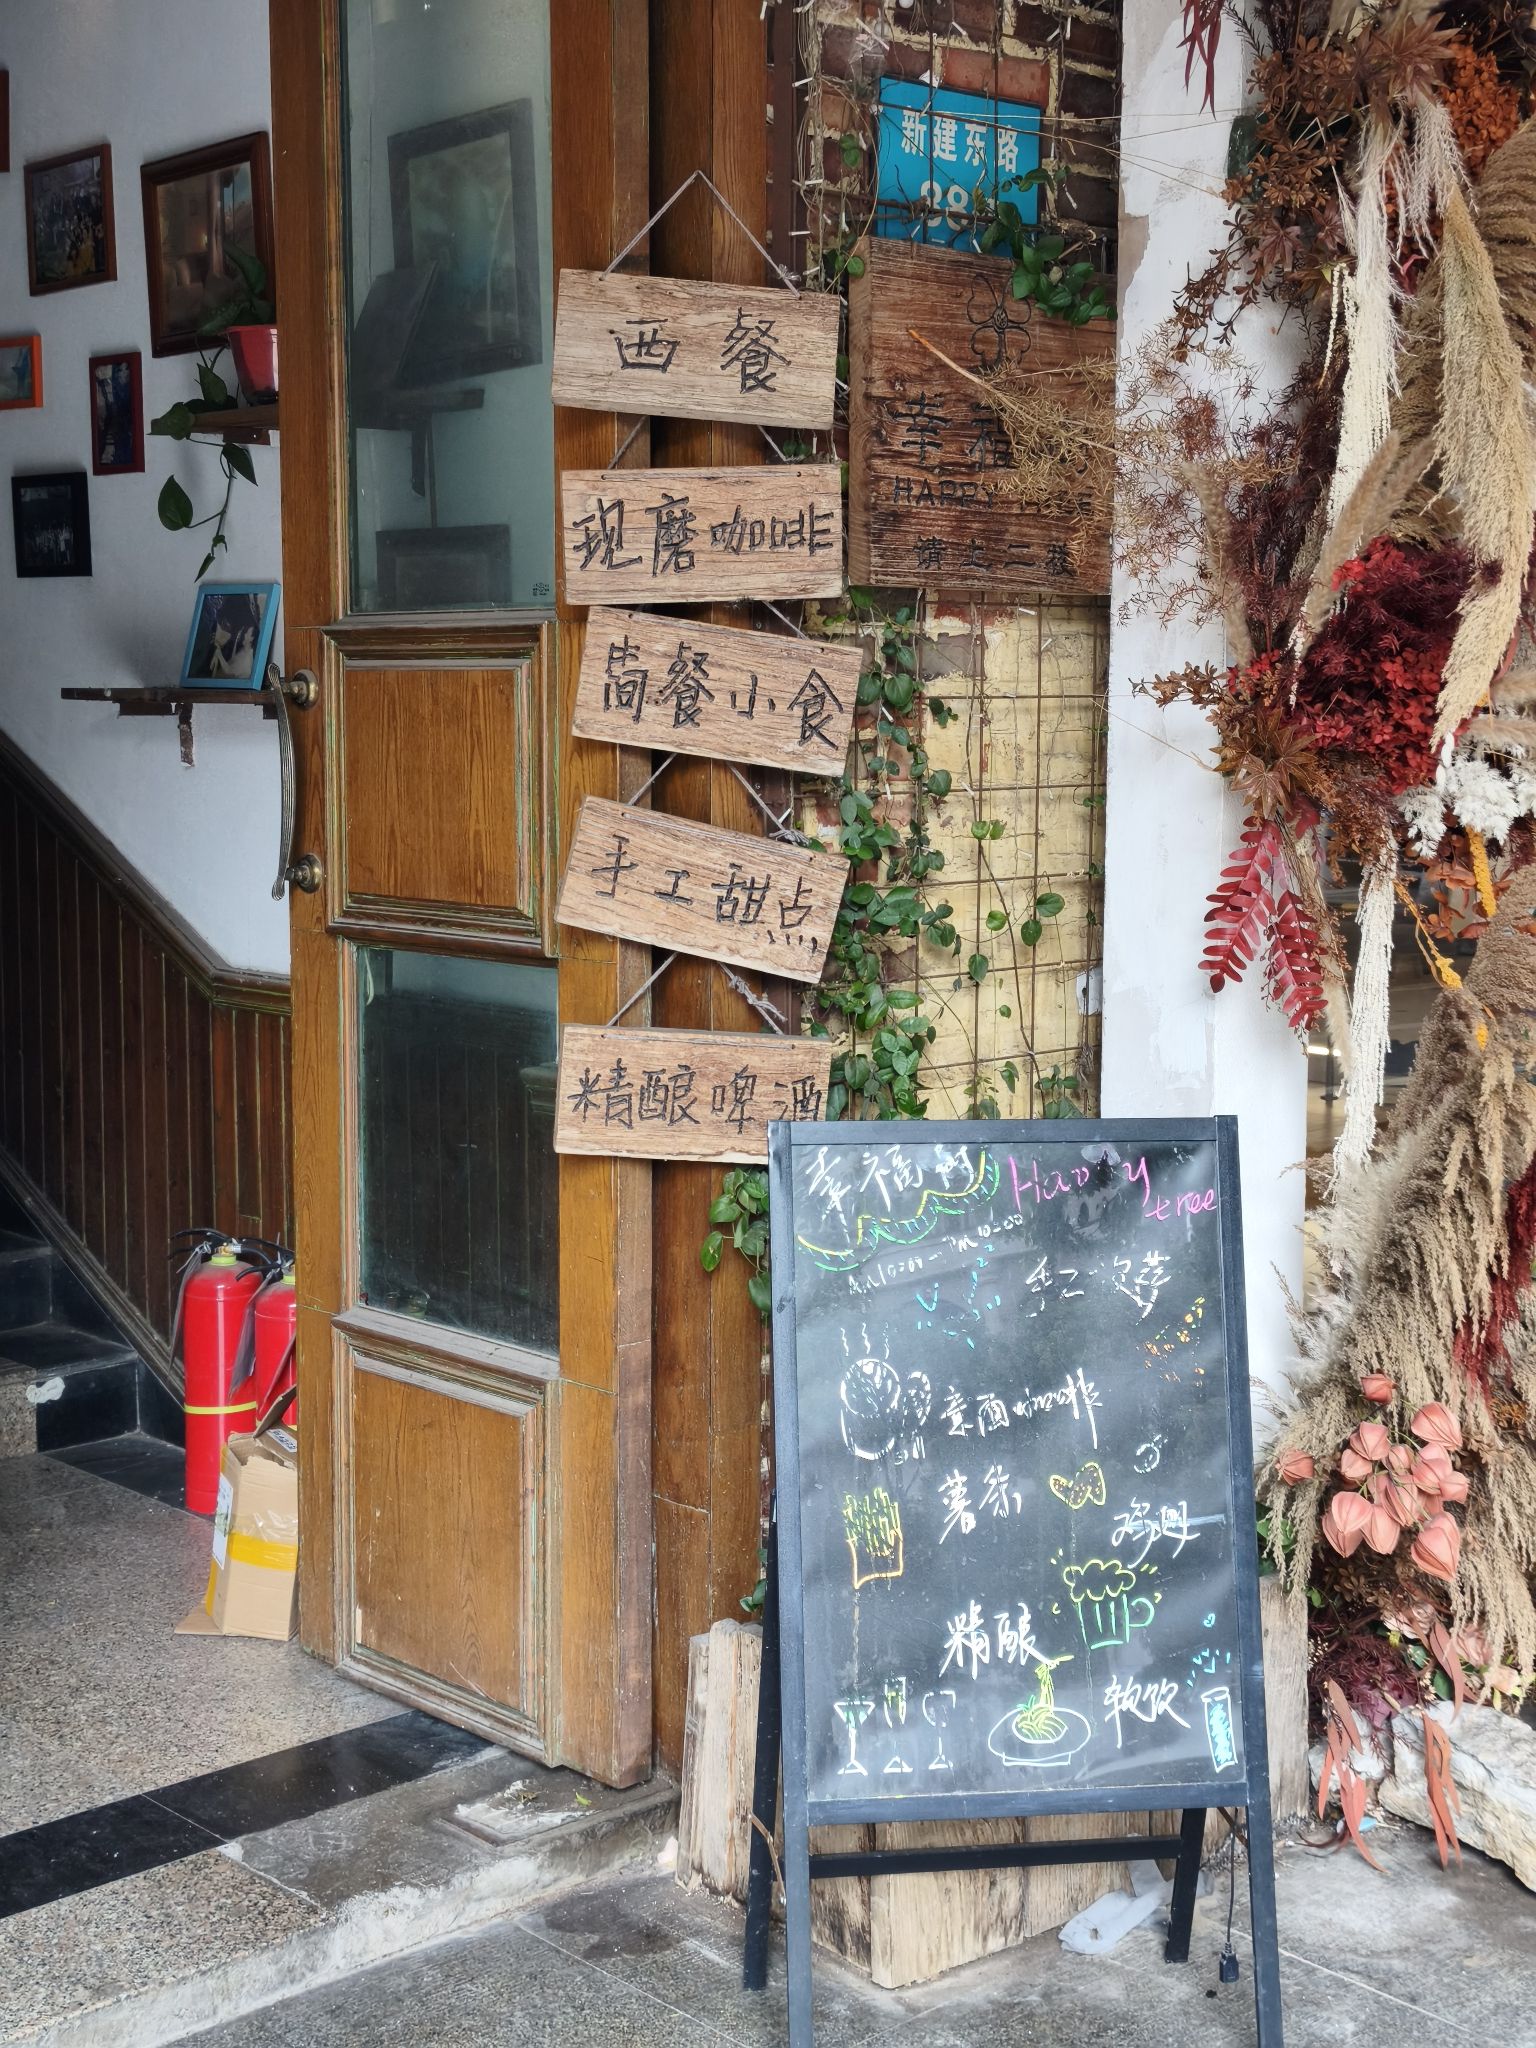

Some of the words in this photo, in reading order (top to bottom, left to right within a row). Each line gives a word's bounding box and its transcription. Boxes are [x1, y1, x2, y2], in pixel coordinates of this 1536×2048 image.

[902, 105, 1018, 173] 新建东路
[614, 306, 791, 394] 西餐
[887, 391, 1090, 474] 幸福
[893, 475, 995, 509] HAPPY
[572, 493, 834, 578] 现磨咖啡
[603, 635, 844, 751] 简餐小食
[591, 833, 818, 954] 手工甜点
[567, 1057, 822, 1135] 精酿啤酒
[1145, 1189, 1217, 1221] tree
[939, 1463, 1022, 1545] 薯条
[939, 1600, 1055, 1680] 精酿
[1104, 1674, 1191, 1749] 软饮
